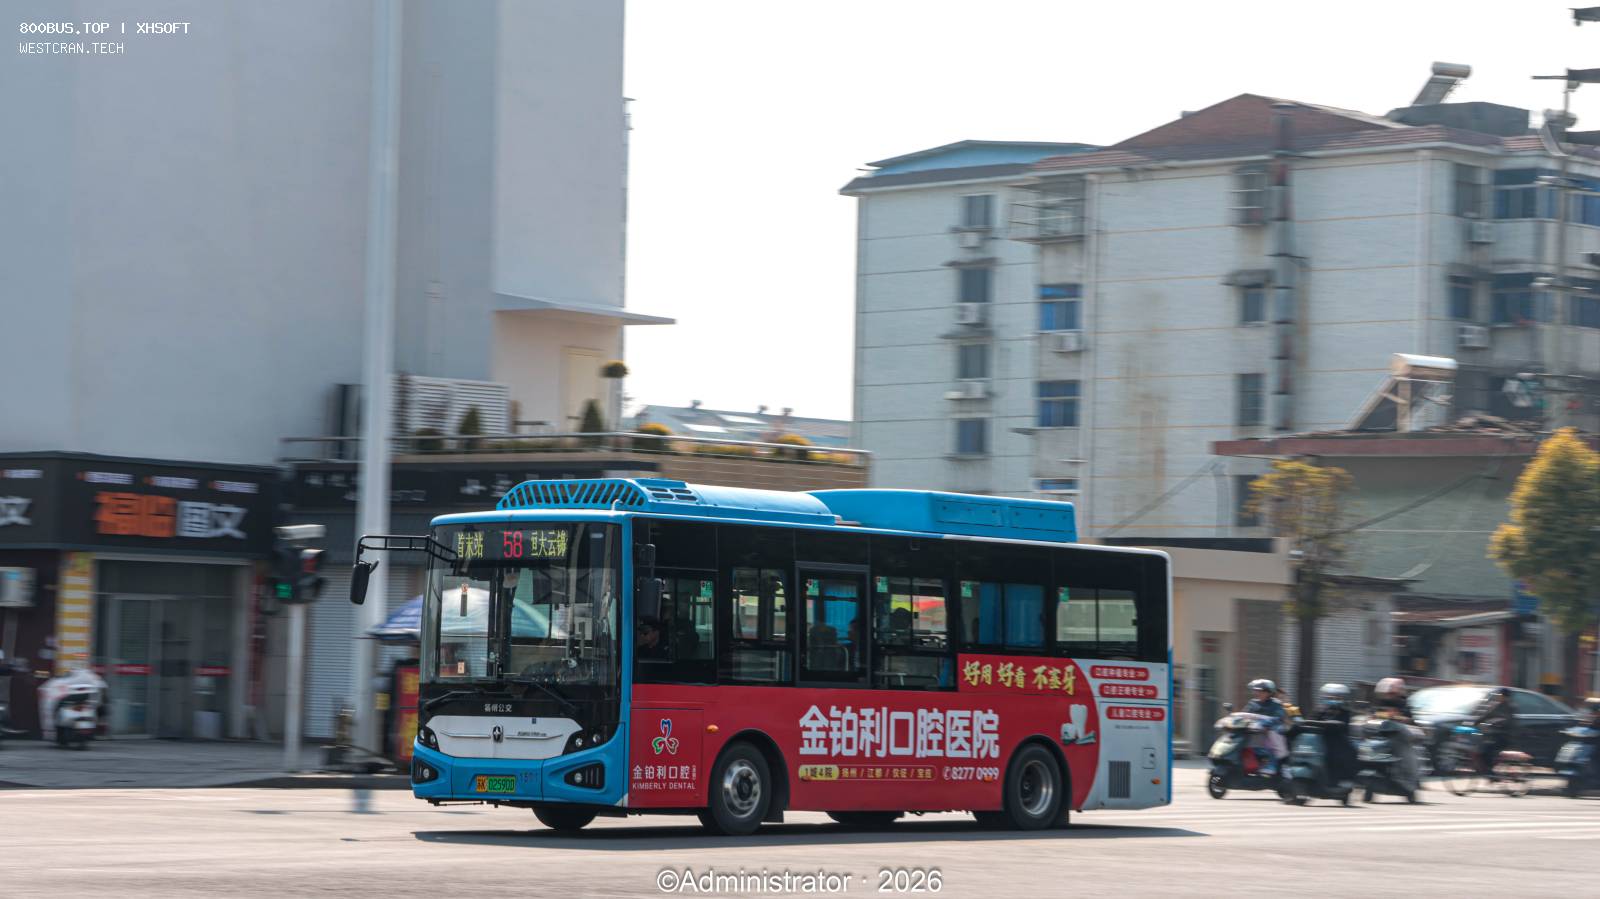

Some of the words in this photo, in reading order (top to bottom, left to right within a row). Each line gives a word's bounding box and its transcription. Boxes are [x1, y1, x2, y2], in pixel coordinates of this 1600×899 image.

[457, 530, 484, 558] 首末站
[503, 531, 524, 558] 58
[963, 660, 993, 687] 好用
[997, 662, 1027, 689] 好看
[1032, 665, 1077, 695] 不塞牙
[798, 704, 1001, 759] 金铂利口腔医院
[632, 765, 690, 780] 金铂利口腔
[951, 766, 975, 780] 8277
[632, 782, 667, 790] KIMBERLY
[668, 782, 697, 790] DENTAL
